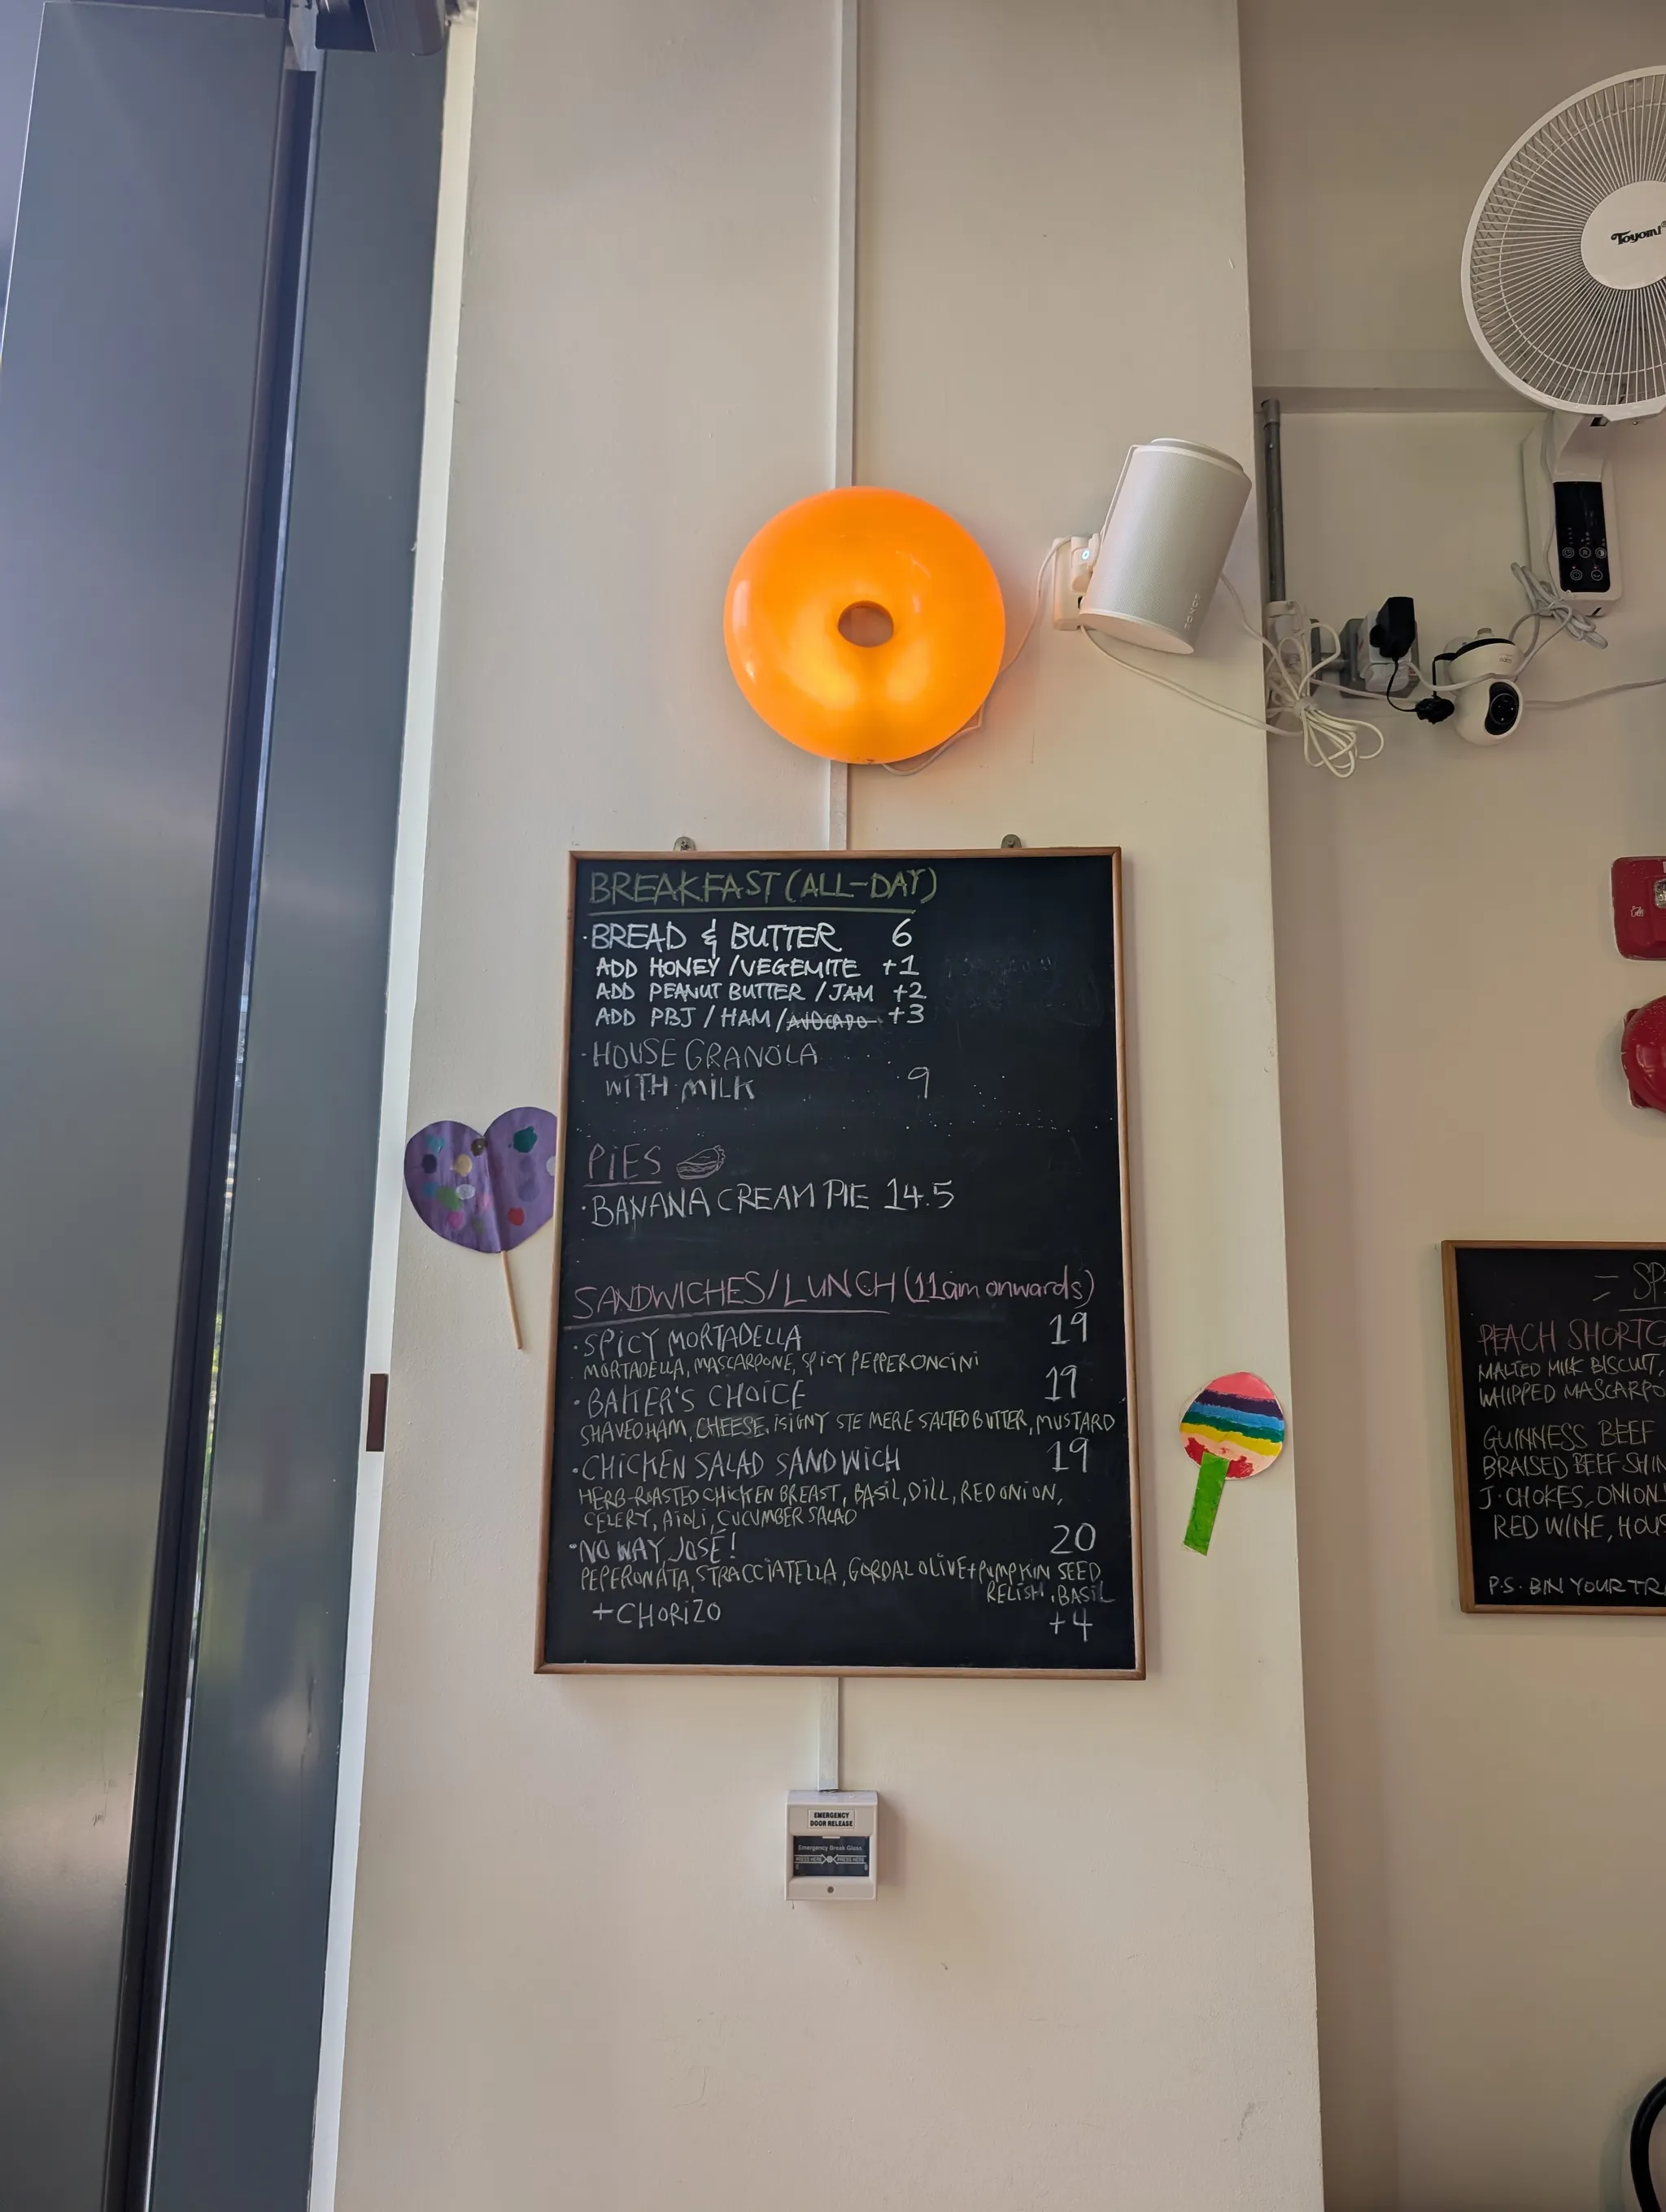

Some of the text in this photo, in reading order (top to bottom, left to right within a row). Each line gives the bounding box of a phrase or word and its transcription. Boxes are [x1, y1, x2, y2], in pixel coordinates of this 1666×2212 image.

[1184, 594, 1201, 629] SONOS
[589, 869, 937, 905] BREAKFAST (ALL-DAY)
[591, 921, 687, 951] BREAD
[731, 921, 842, 951] BUTTER
[892, 918, 913, 947] 6
[596, 957, 637, 978] ADD
[650, 956, 720, 978] HONEY
[883, 955, 919, 976] +1
[596, 982, 635, 999] ADD
[649, 982, 722, 1001] PEANUT
[729, 982, 805, 1000] BUTTER
[893, 982, 927, 1002] +2
[595, 1008, 636, 1027] ADD
[651, 1008, 696, 1026] PBJ
[888, 1004, 924, 1025] +3
[593, 1038, 818, 1070] HOUSE GRANOLA
[606, 1073, 669, 1100] WITH
[908, 1067, 930, 1099] 9
[589, 1143, 661, 1180] PIES
[591, 1178, 954, 1226] BANANA CREAM PIE 14.5
[904, 1266, 979, 1303] (11am
[985, 1265, 1095, 1308] onwards)
[1633, 1261, 1666, 1304] SP
[669, 1322, 801, 1357] MORTADELLA
[1049, 1312, 1088, 1344] 19
[1478, 1321, 1556, 1356] PEACH
[584, 1361, 690, 1380] MORTADELLA,
[694, 1352, 796, 1375] MASCARPONE,
[852, 1351, 979, 1376] PEPPERONCINI
[1479, 1353, 1664, 1382] MALTED MILK BISCUIT,
[709, 1379, 807, 1410] CHOICE
[1045, 1365, 1077, 1401] 19
[1480, 1382, 1555, 1409] WHIPPED
[696, 1416, 770, 1439] CHEESE,
[836, 1413, 862, 1431] STE
[869, 1409, 914, 1432] MERE
[918, 1410, 970, 1432] SALTED
[973, 1409, 1033, 1435] BUTTER,
[1037, 1412, 1115, 1435] MUSTARD
[1484, 1417, 1655, 1456] GUINNESS BEEF
[582, 1437, 1088, 1482] CHICKEN SALAD SANDWICH 19
[1483, 1457, 1568, 1479] BRAISED
[1572, 1452, 1620, 1475] BEEF
[579, 1486, 700, 1510] HERB-ROASTED
[703, 1485, 773, 1509] CHICKEN
[780, 1483, 846, 1507] BREAST,
[961, 1483, 996, 1504] RED
[585, 1509, 657, 1533] CELERY,
[717, 1508, 804, 1527] CUCUMBER
[810, 1506, 857, 1526] SALAD
[1494, 1514, 1538, 1539] RED
[1546, 1512, 1612, 1543] WINE,
[580, 1540, 610, 1563] NO
[1050, 1522, 1096, 1553] 20
[848, 1557, 914, 1584] GORDAL
[1058, 1561, 1101, 1581] SEED
[1529, 1577, 1564, 1595] BIN
[1570, 1577, 1626, 1596] YOUR
[1627, 1576, 1666, 1596] TR
[1050, 1608, 1093, 1642] +4
